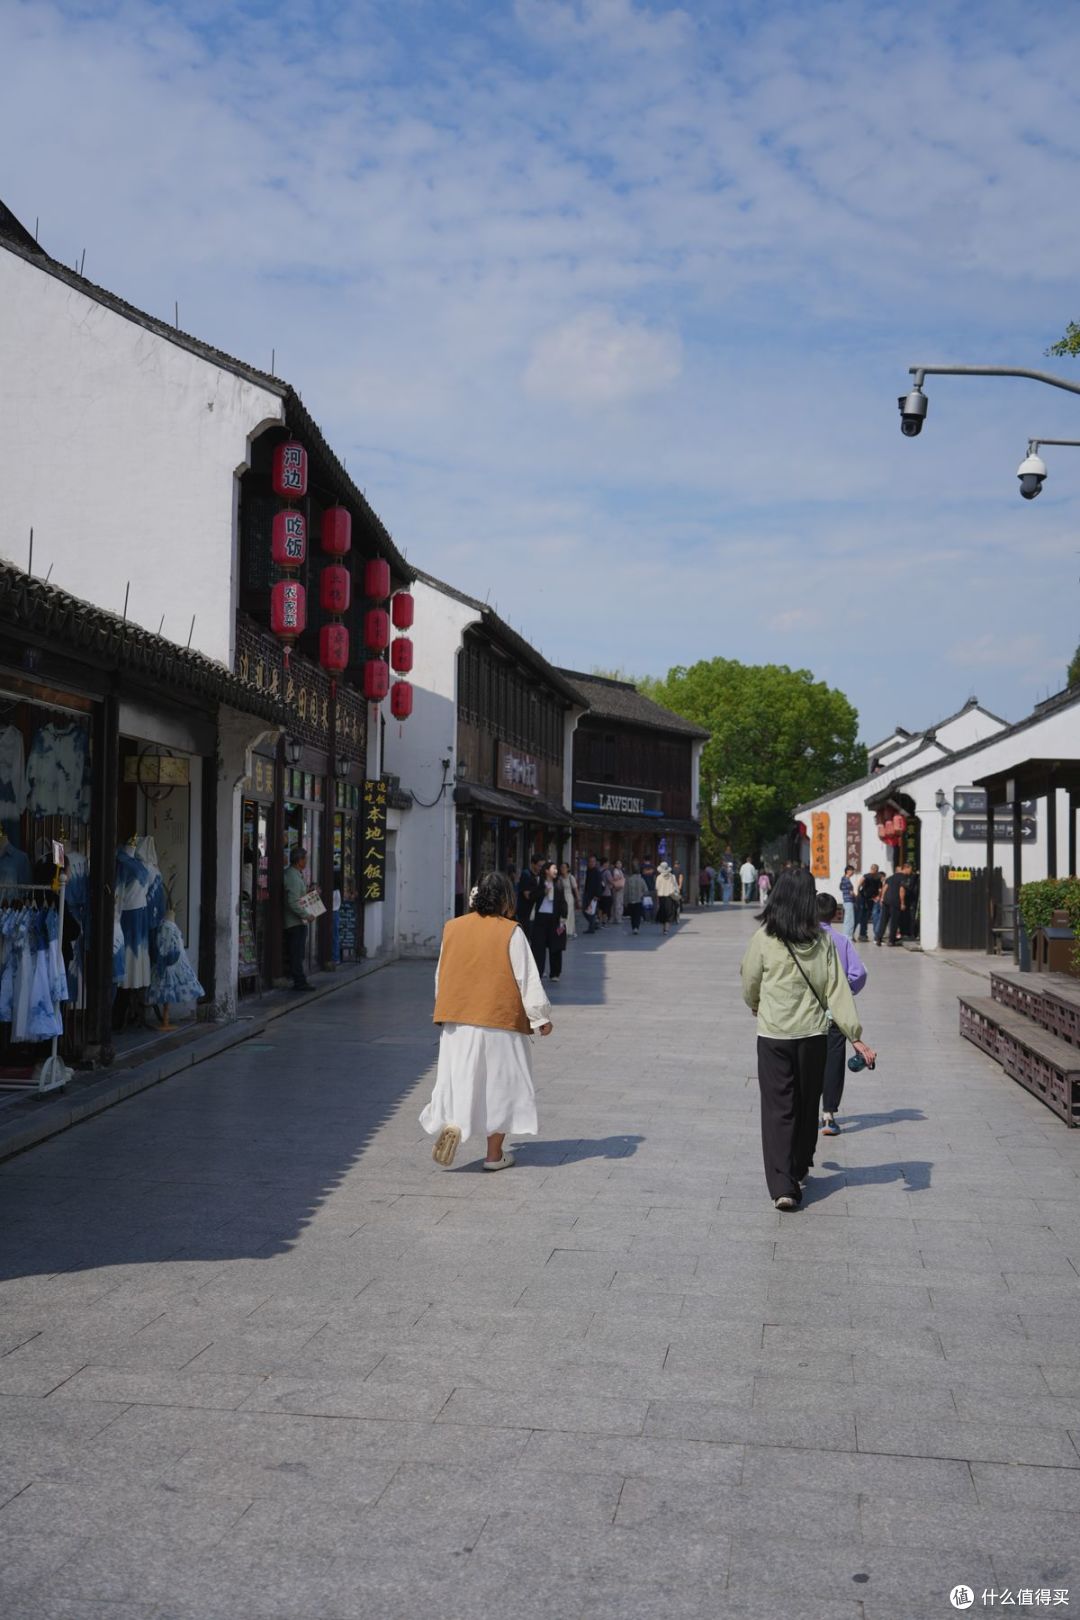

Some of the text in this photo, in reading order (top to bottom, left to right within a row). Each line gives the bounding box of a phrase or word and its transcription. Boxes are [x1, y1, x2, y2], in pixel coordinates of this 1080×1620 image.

[284, 447, 302, 489] 河边
[286, 516, 304, 558] 吃饭
[284, 586, 298, 628] 农家菜
[599, 793, 641, 813] LAWSON
